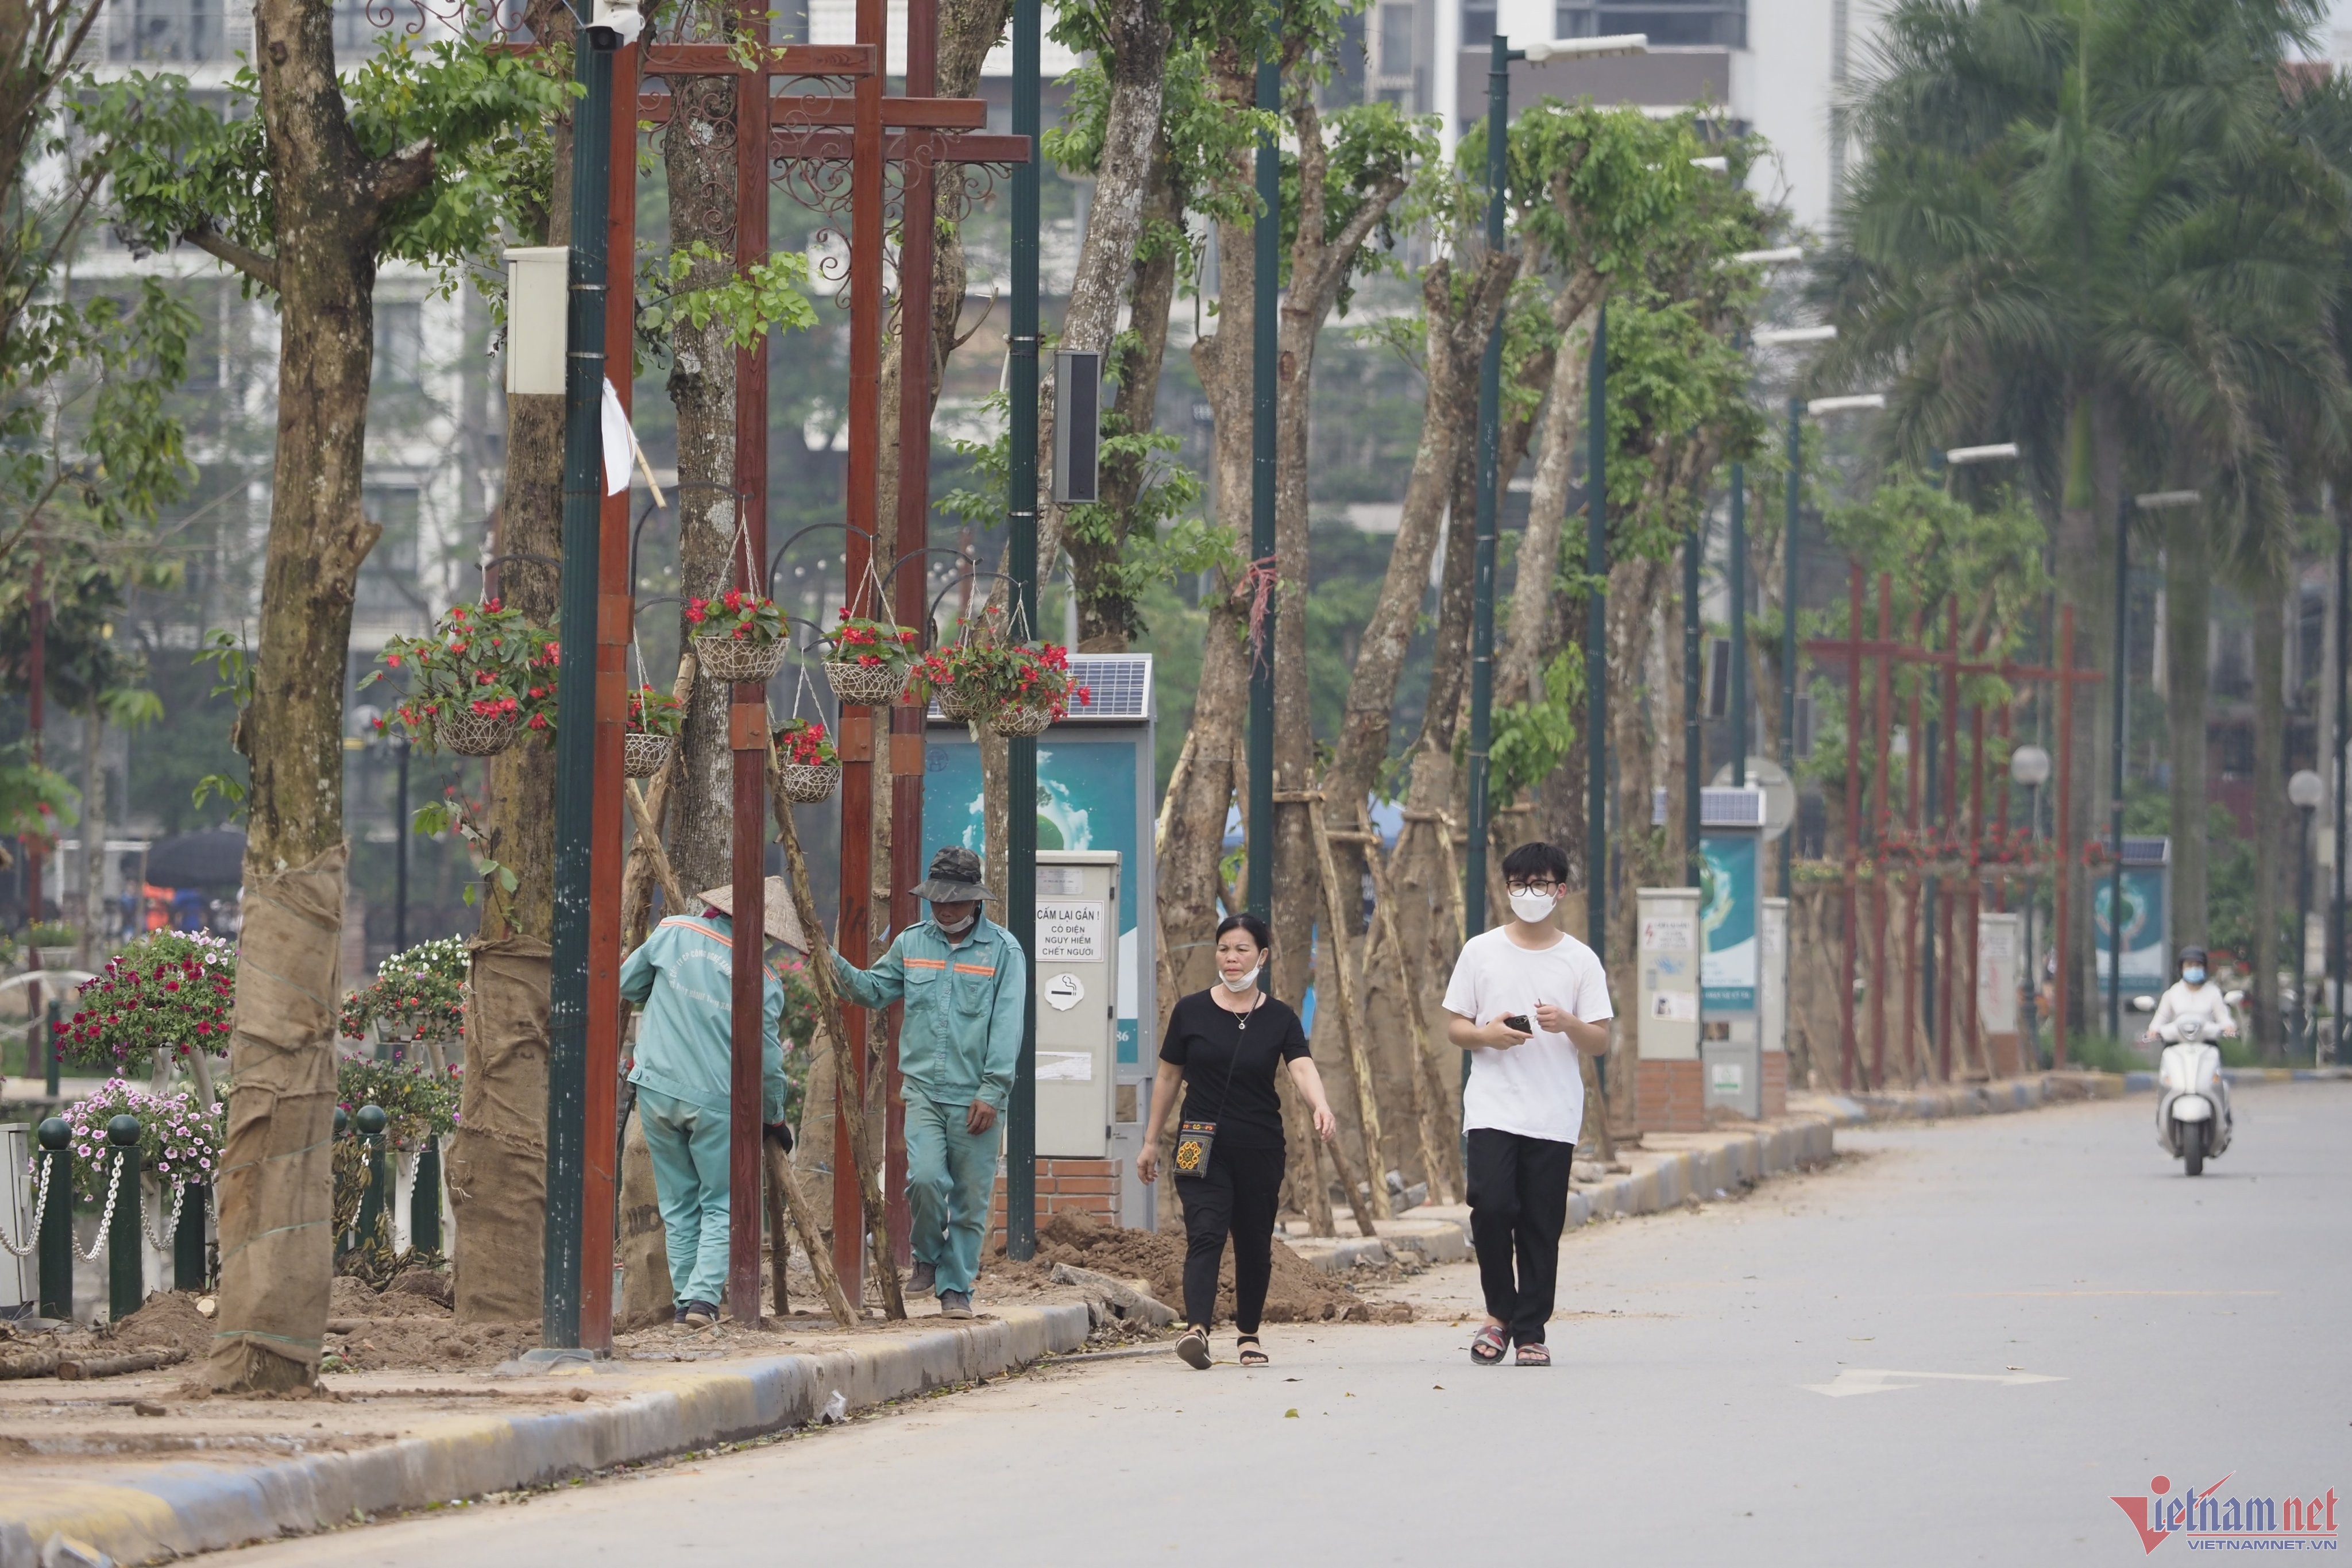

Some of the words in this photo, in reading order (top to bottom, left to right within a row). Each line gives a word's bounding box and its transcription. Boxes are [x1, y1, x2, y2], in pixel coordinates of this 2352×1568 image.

[1037, 906, 1056, 920] CẤM
[1059, 910, 1073, 922] LẠI
[1096, 911, 1099, 920] !
[1066, 925, 1085, 934] ĐIỆN
[1042, 945, 1064, 955] CHẾT
[1067, 947, 1094, 956] NGƯỜI
